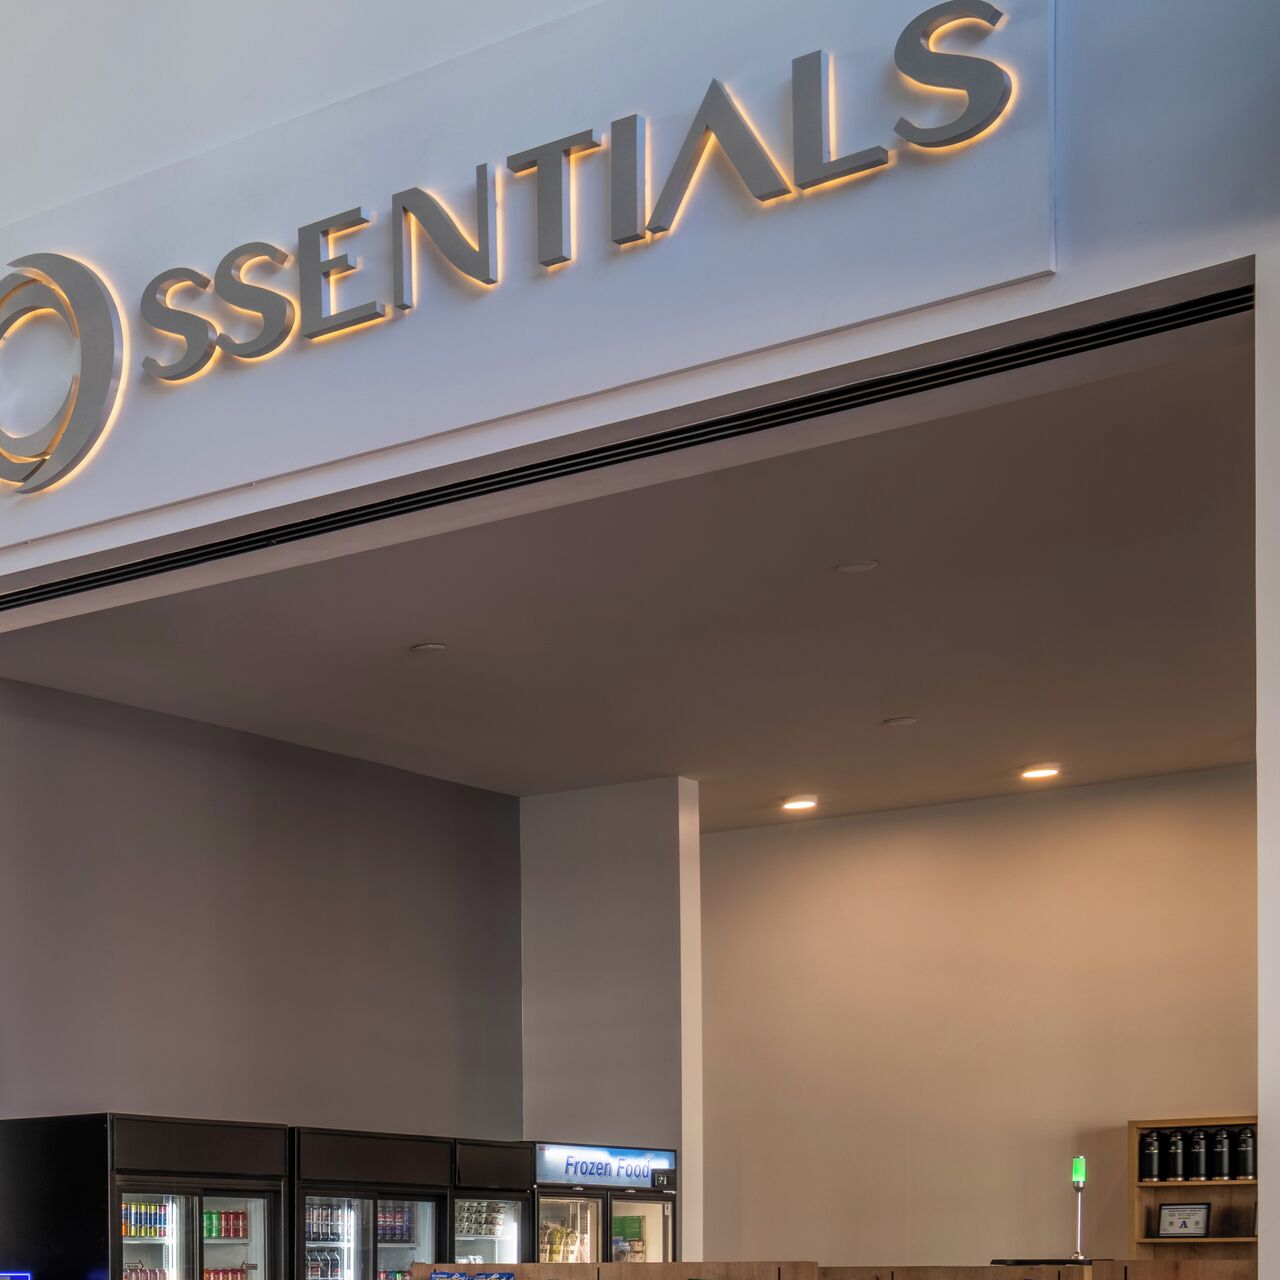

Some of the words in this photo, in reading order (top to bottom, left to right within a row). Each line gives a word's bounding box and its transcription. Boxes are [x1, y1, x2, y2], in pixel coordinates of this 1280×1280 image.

[565, 1156, 611, 1178] Frozen
[617, 1158, 650, 1179] Food
[1179, 1220, 1188, 1229] A
